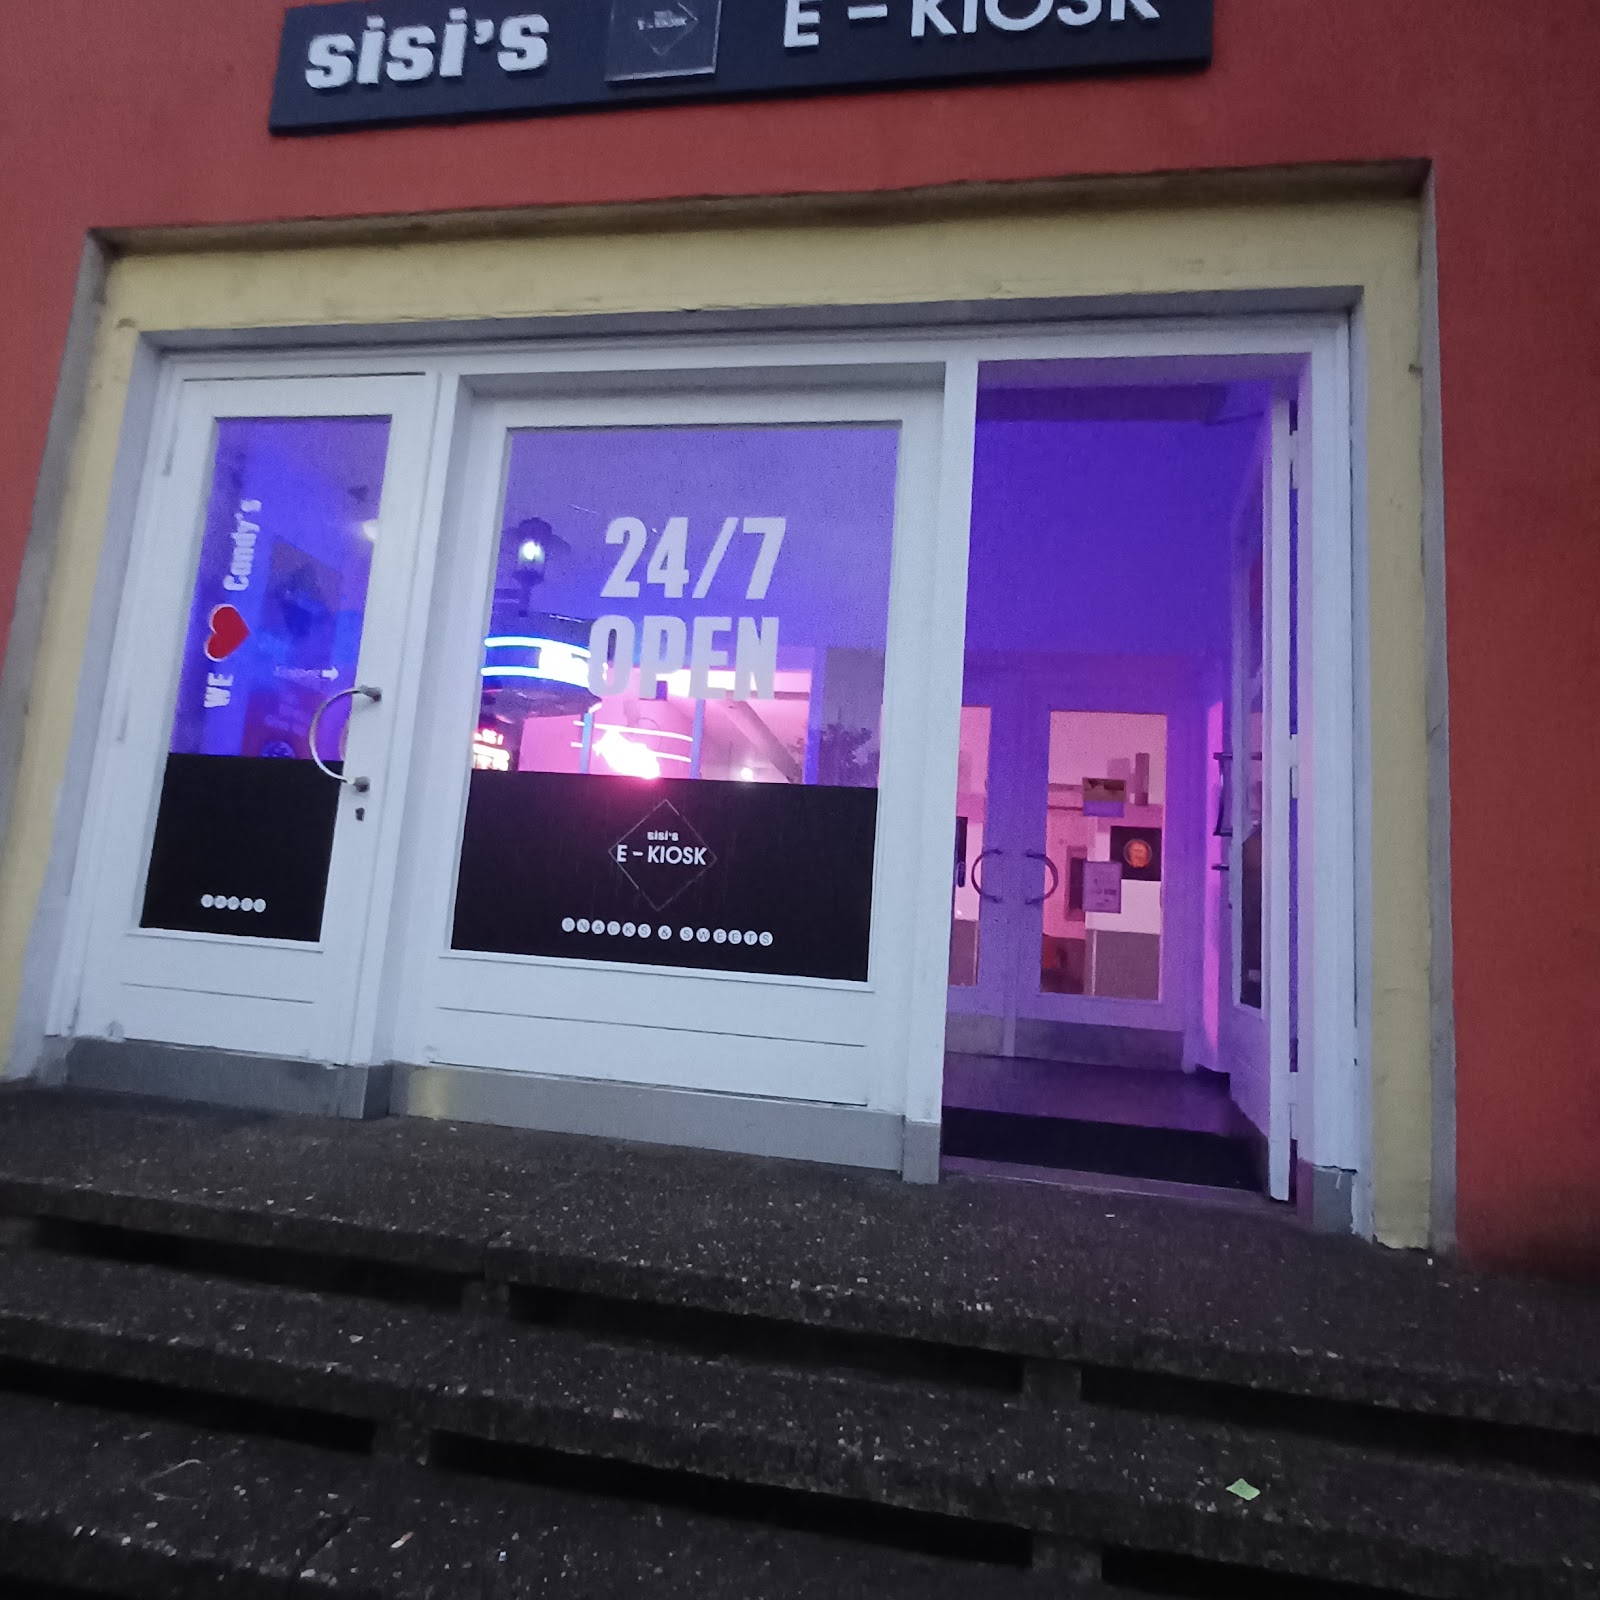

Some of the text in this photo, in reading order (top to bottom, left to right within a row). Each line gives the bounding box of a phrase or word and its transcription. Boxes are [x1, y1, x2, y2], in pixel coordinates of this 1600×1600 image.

[305, 7, 550, 89] sisi's
[783, 0, 821, 47] E
[600, 516, 787, 600] 24/7
[203, 499, 263, 708] WE Candy's
[588, 615, 780, 701] OPEN
[616, 844, 628, 862] E
[647, 845, 708, 866] KIOSK
[646, 830, 679, 842] sisi's
[561, 916, 774, 947] SNACKS & SWEETS
